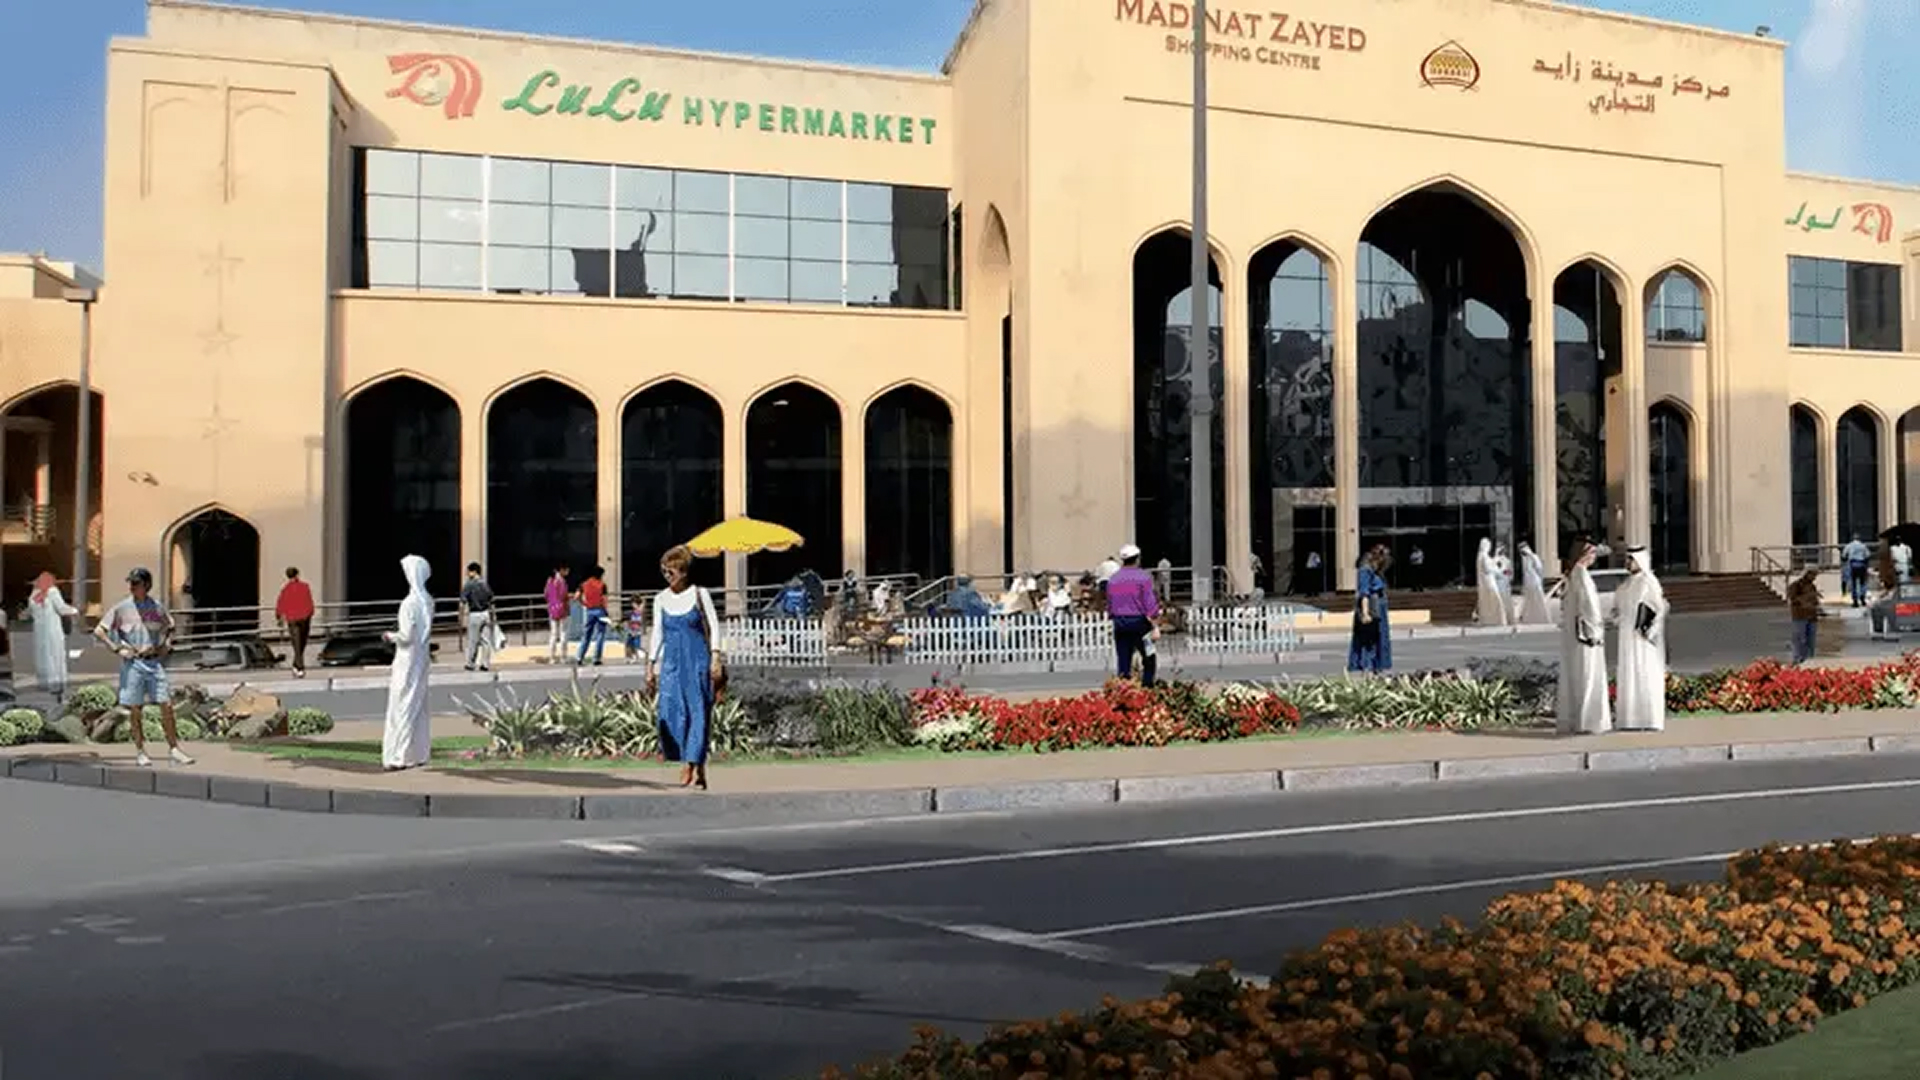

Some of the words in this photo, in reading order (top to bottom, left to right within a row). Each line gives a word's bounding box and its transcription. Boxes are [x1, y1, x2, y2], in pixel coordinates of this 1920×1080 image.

[1115, 0, 1262, 39] MADNAT
[1269, 12, 1367, 52] ZAYED
[1255, 46, 1322, 71] CENTRE
[1532, 50, 1581, 82] زايد
[1590, 59, 1663, 88] مدينة
[1671, 74, 1730, 101] مركز
[502, 69, 672, 123] LuLu
[683, 96, 938, 145] HYPERMARKET
[1588, 88, 1656, 115] التجاري
